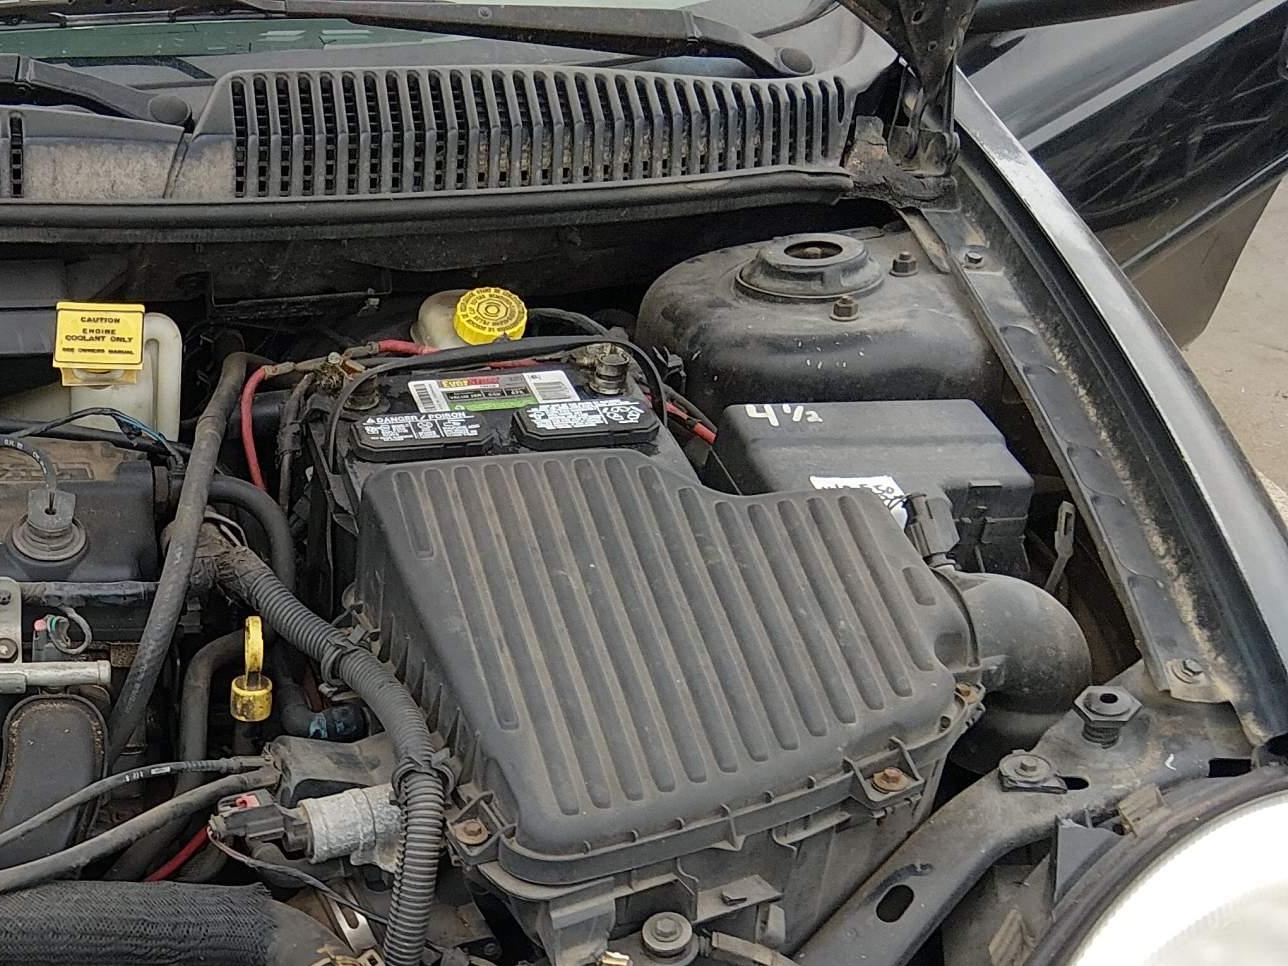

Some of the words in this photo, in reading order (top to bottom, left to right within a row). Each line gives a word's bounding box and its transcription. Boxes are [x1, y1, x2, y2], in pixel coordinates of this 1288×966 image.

[80, 316, 121, 324] CAUTION
[376, 415, 418, 424] DANGER
[427, 411, 467, 421] POISON
[744, 403, 780, 427] 4
